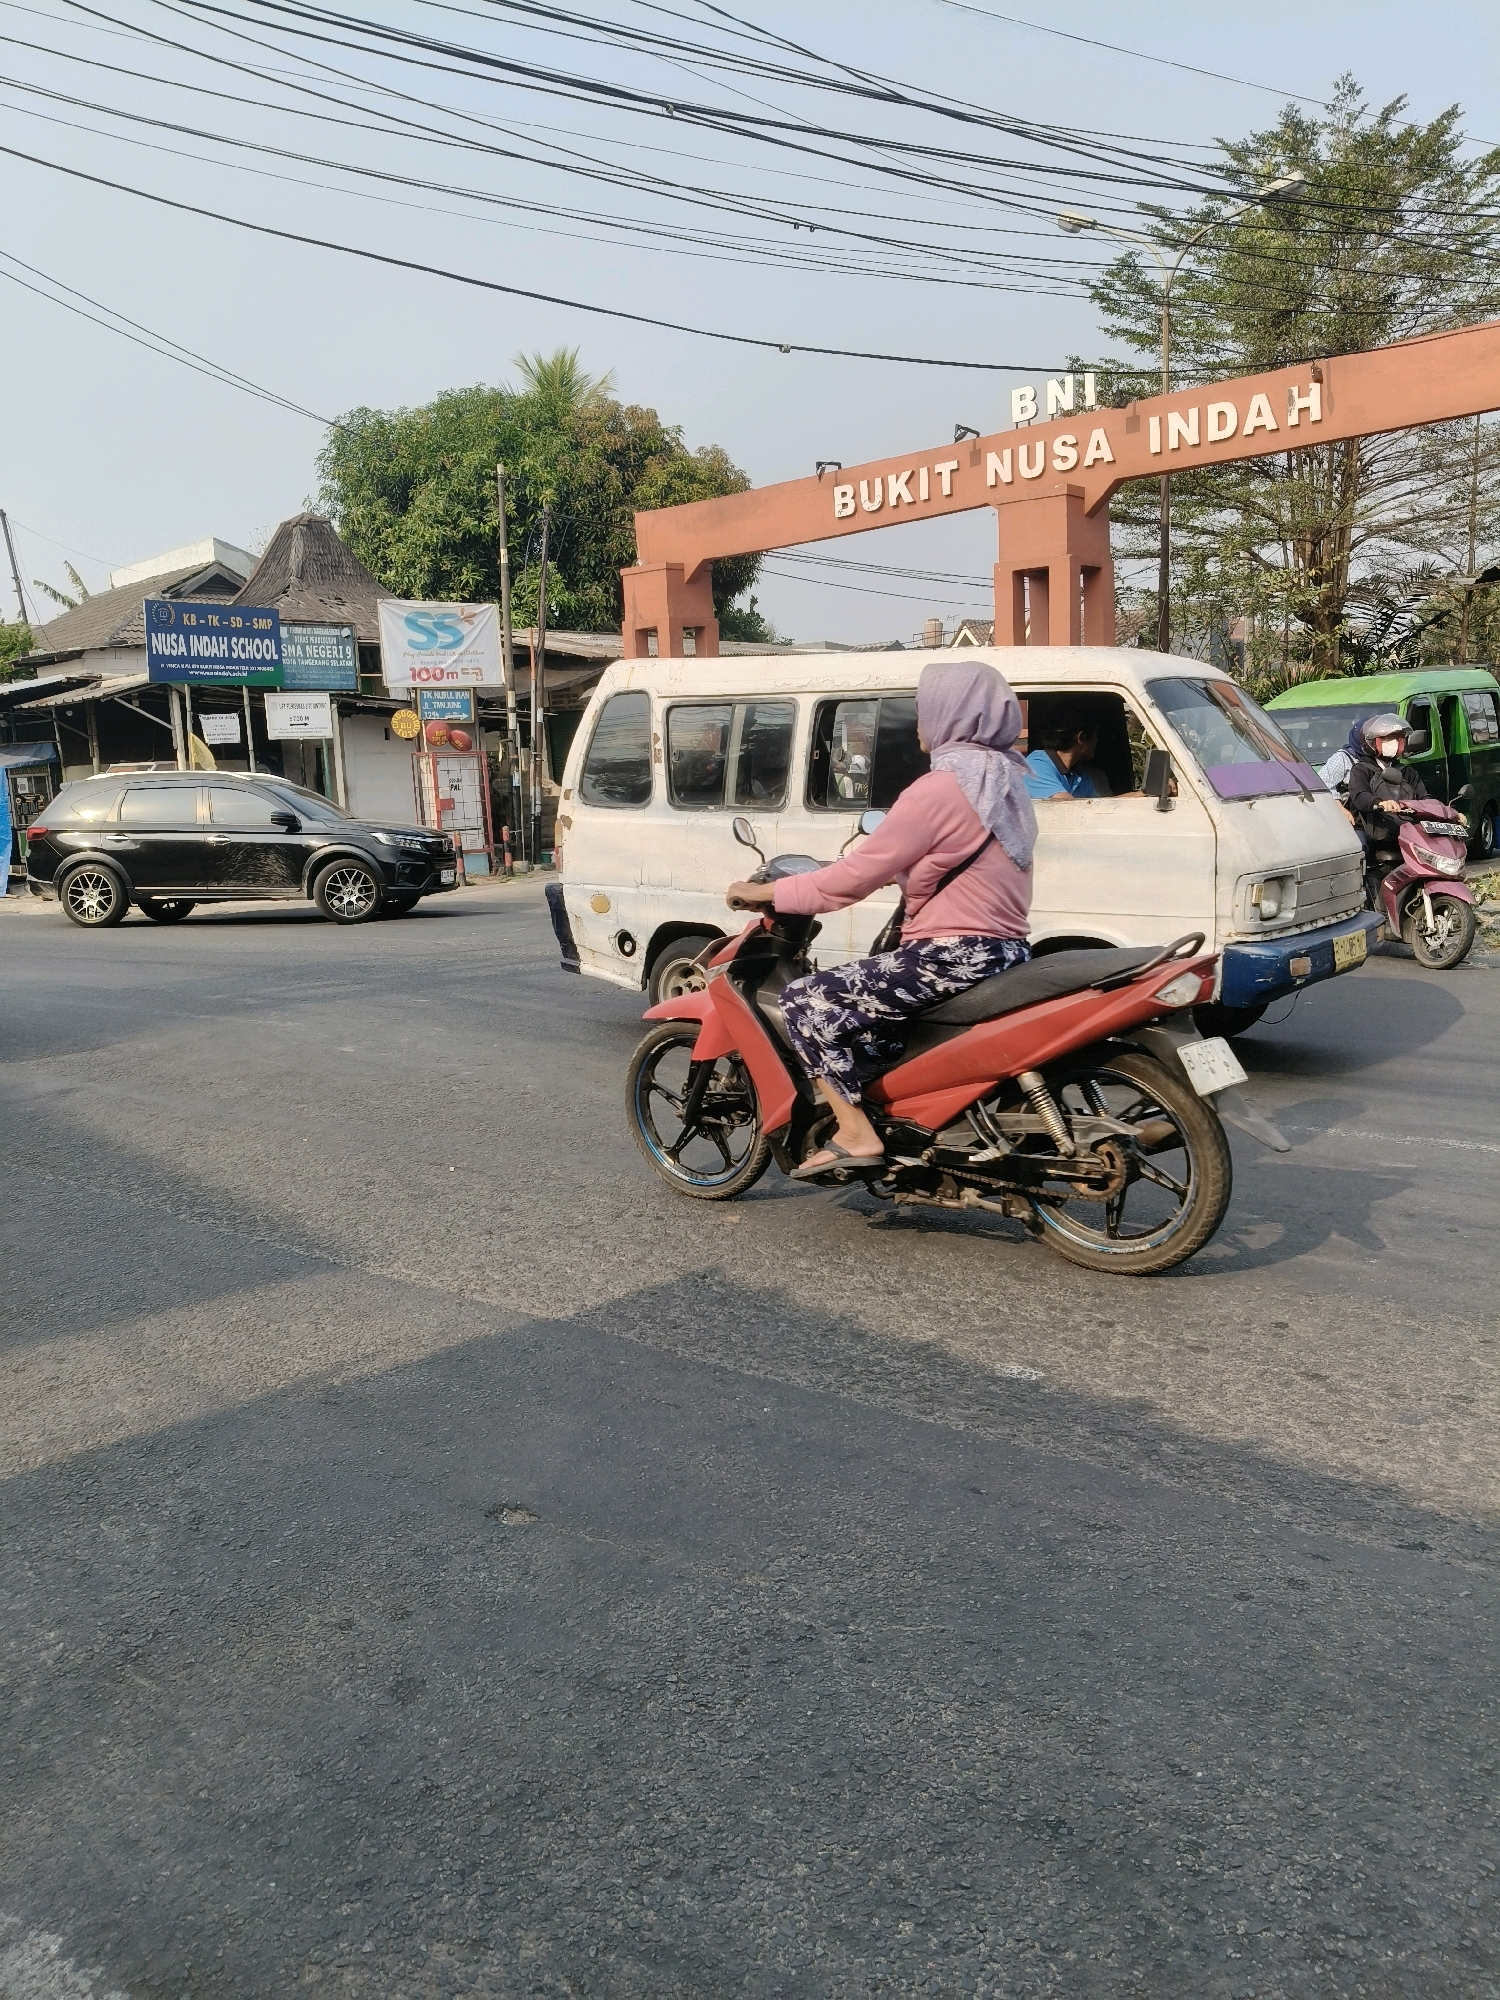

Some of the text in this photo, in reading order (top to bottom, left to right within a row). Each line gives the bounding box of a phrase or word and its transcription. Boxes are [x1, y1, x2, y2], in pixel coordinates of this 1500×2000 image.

[1012, 372, 1099, 424] BNI
[833, 382, 1322, 518] BUKIT NUSA INDAH
[183, 613, 273, 630] KB TK SD SMP
[404, 611, 465, 651] SS
[151, 632, 279, 661] NUSA INDAH SCHOOL
[281, 643, 352, 659] SMA NEGERI 9
[298, 658, 329, 667] TANGERANG
[409, 667, 459, 682] 100 m
